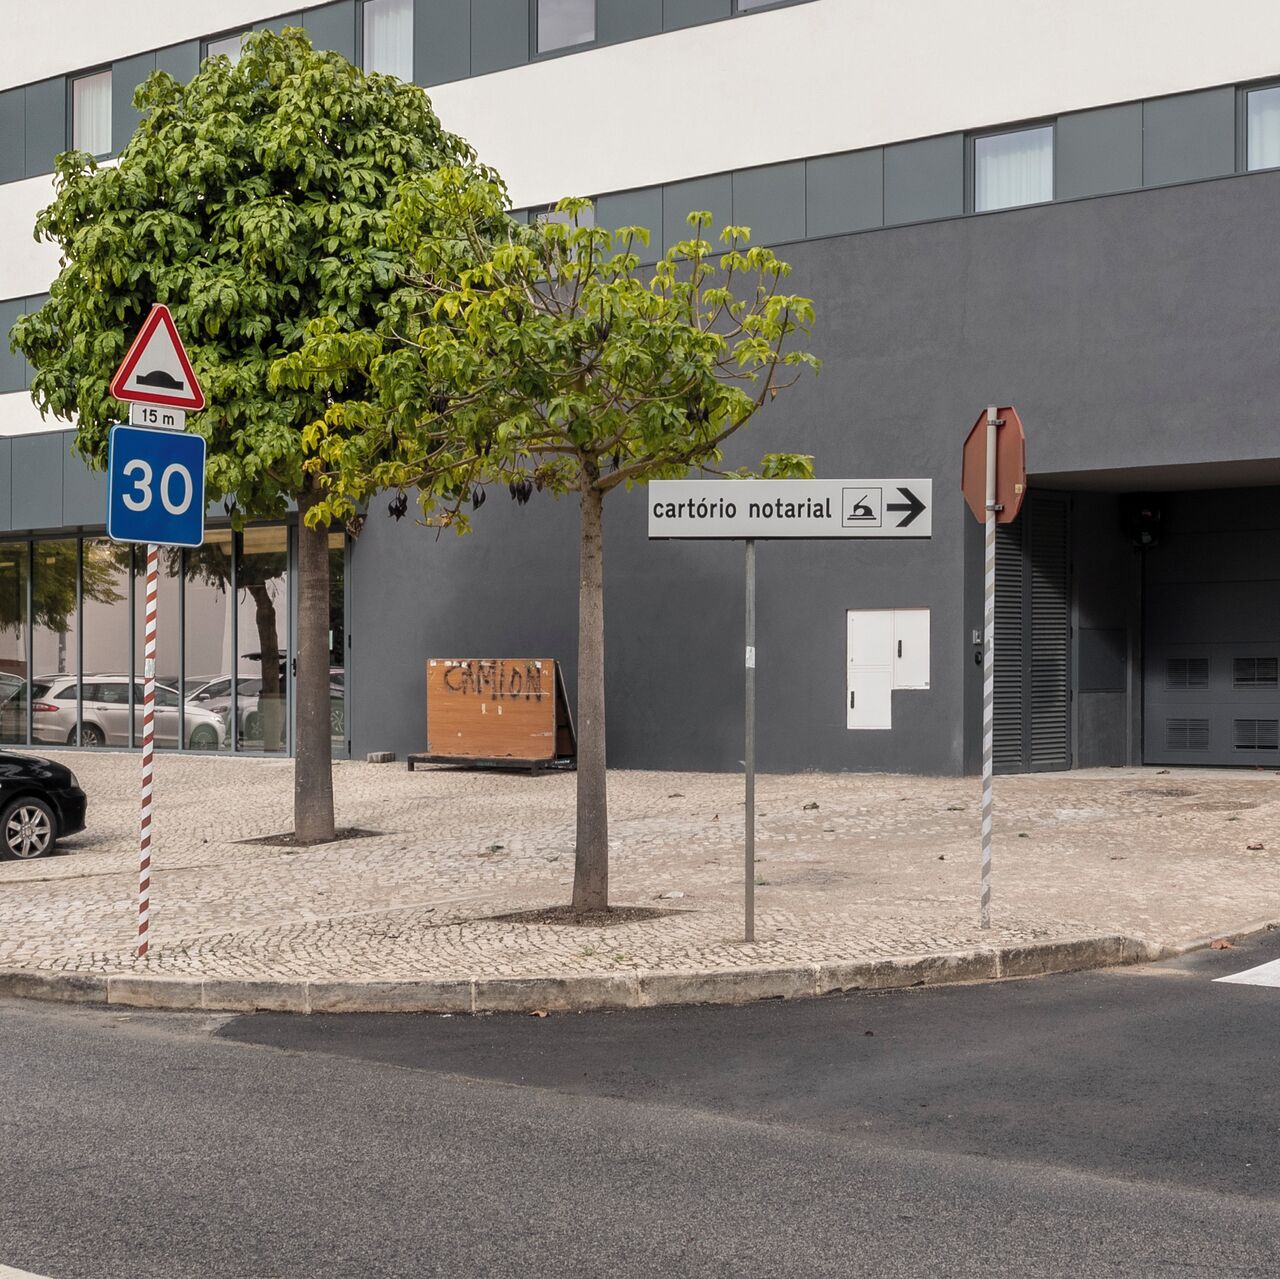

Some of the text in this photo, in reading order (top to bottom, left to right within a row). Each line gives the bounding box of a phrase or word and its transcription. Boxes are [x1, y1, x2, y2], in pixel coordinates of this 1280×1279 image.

[142, 408, 175, 426] 15 m
[122, 459, 193, 515] 30
[653, 497, 832, 519] cartório notarial
